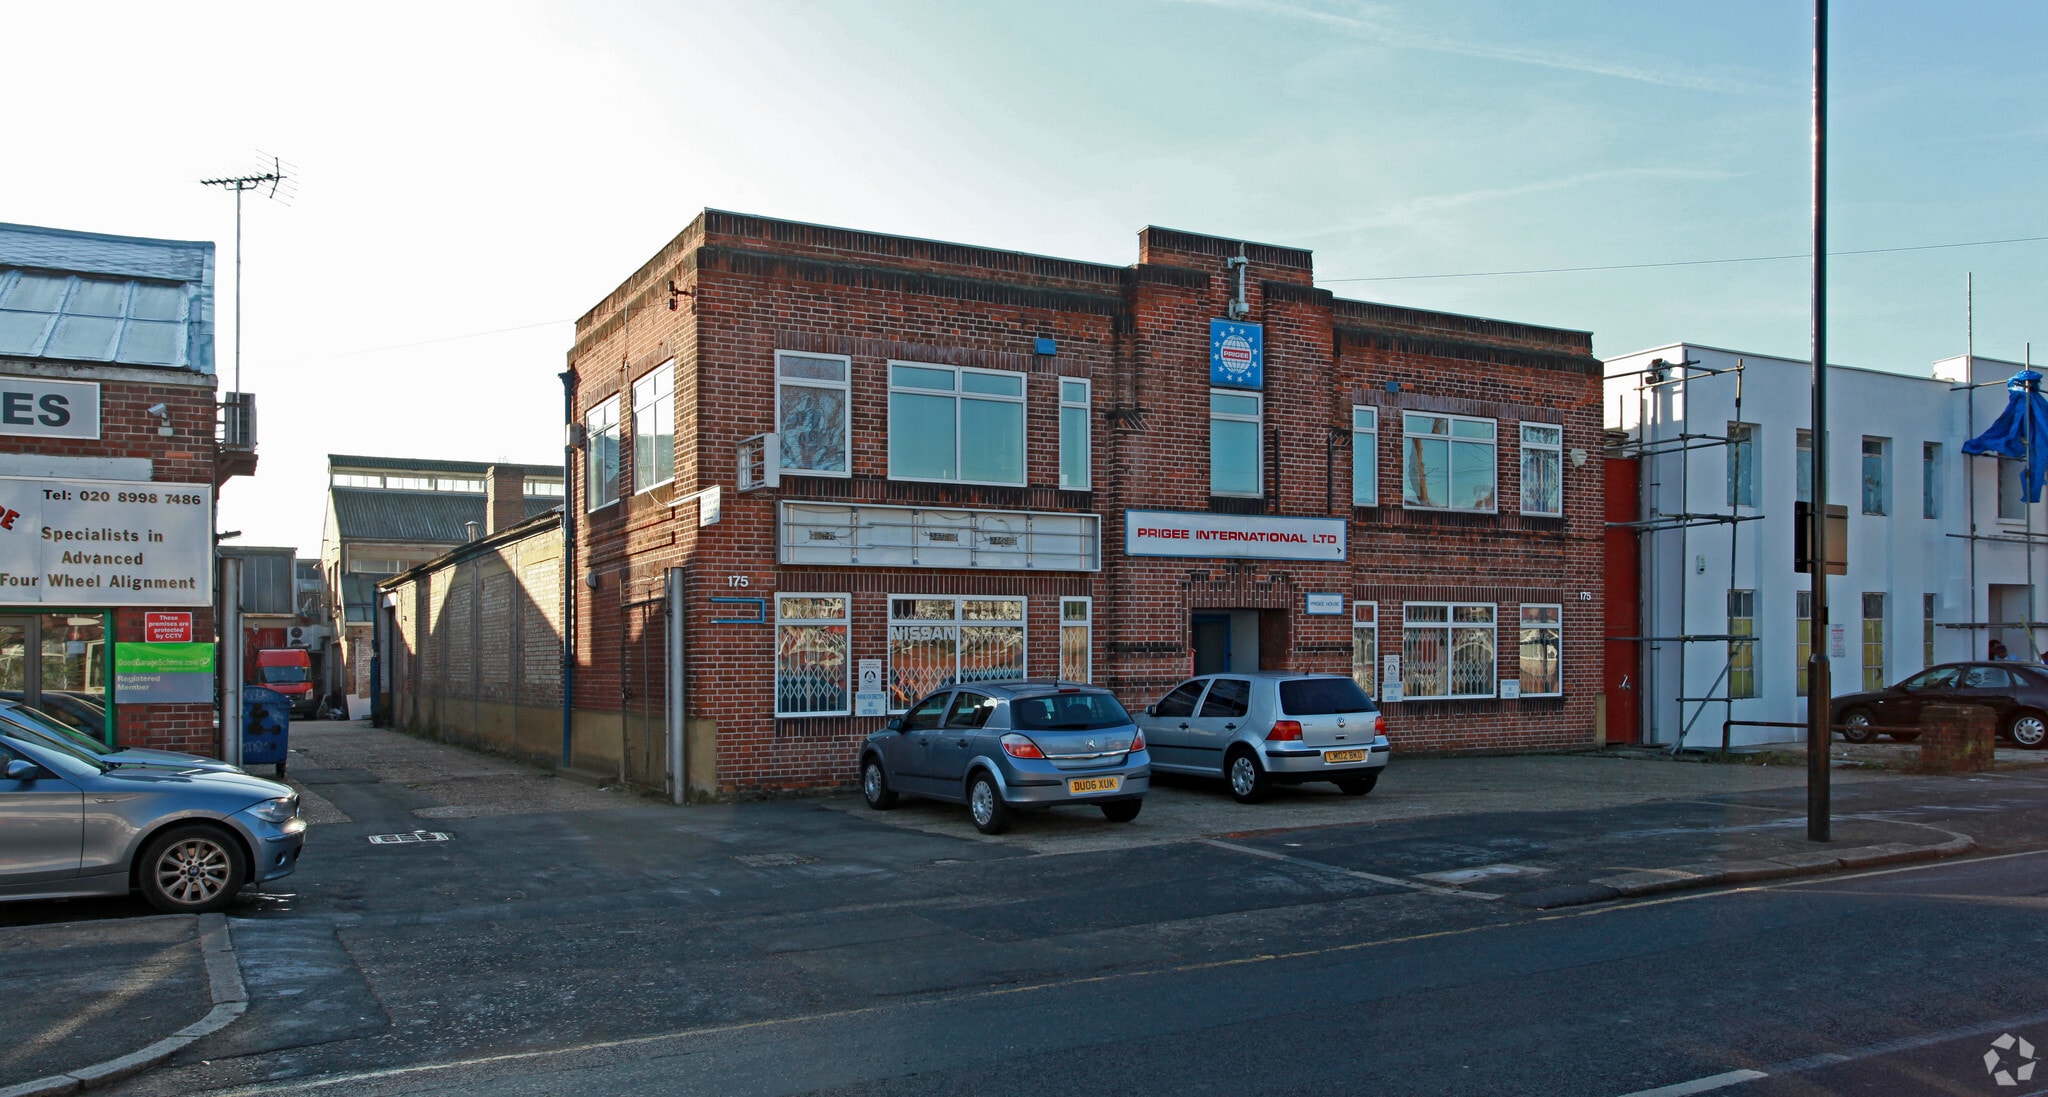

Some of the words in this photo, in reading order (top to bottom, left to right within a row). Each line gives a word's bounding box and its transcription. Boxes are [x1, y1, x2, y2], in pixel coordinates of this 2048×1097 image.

[1223, 350, 1250, 359] PRIGEE
[2, 392, 71, 427] ES
[43, 489, 72, 501] Tel:
[79, 490, 110, 502] 020
[117, 492, 158, 504] 8998
[165, 494, 201, 505] 7486
[41, 526, 140, 542] Specialists
[148, 529, 164, 543] in
[1137, 528, 1190, 540] PRIGEE
[1195, 530, 1308, 544] INTERNATIONAL
[1312, 533, 1338, 545] LTD
[61, 550, 144, 566] Advanced
[0, 573, 39, 587] Four
[48, 573, 101, 588] Wheel
[109, 575, 196, 591] Alignment
[728, 575, 749, 588] 175
[1580, 591, 1592, 601] 175
[890, 625, 957, 641] NISSAN
[117, 675, 161, 684] Registered
[1074, 780, 1097, 791] DU06
[1098, 778, 1115, 789] XUK
